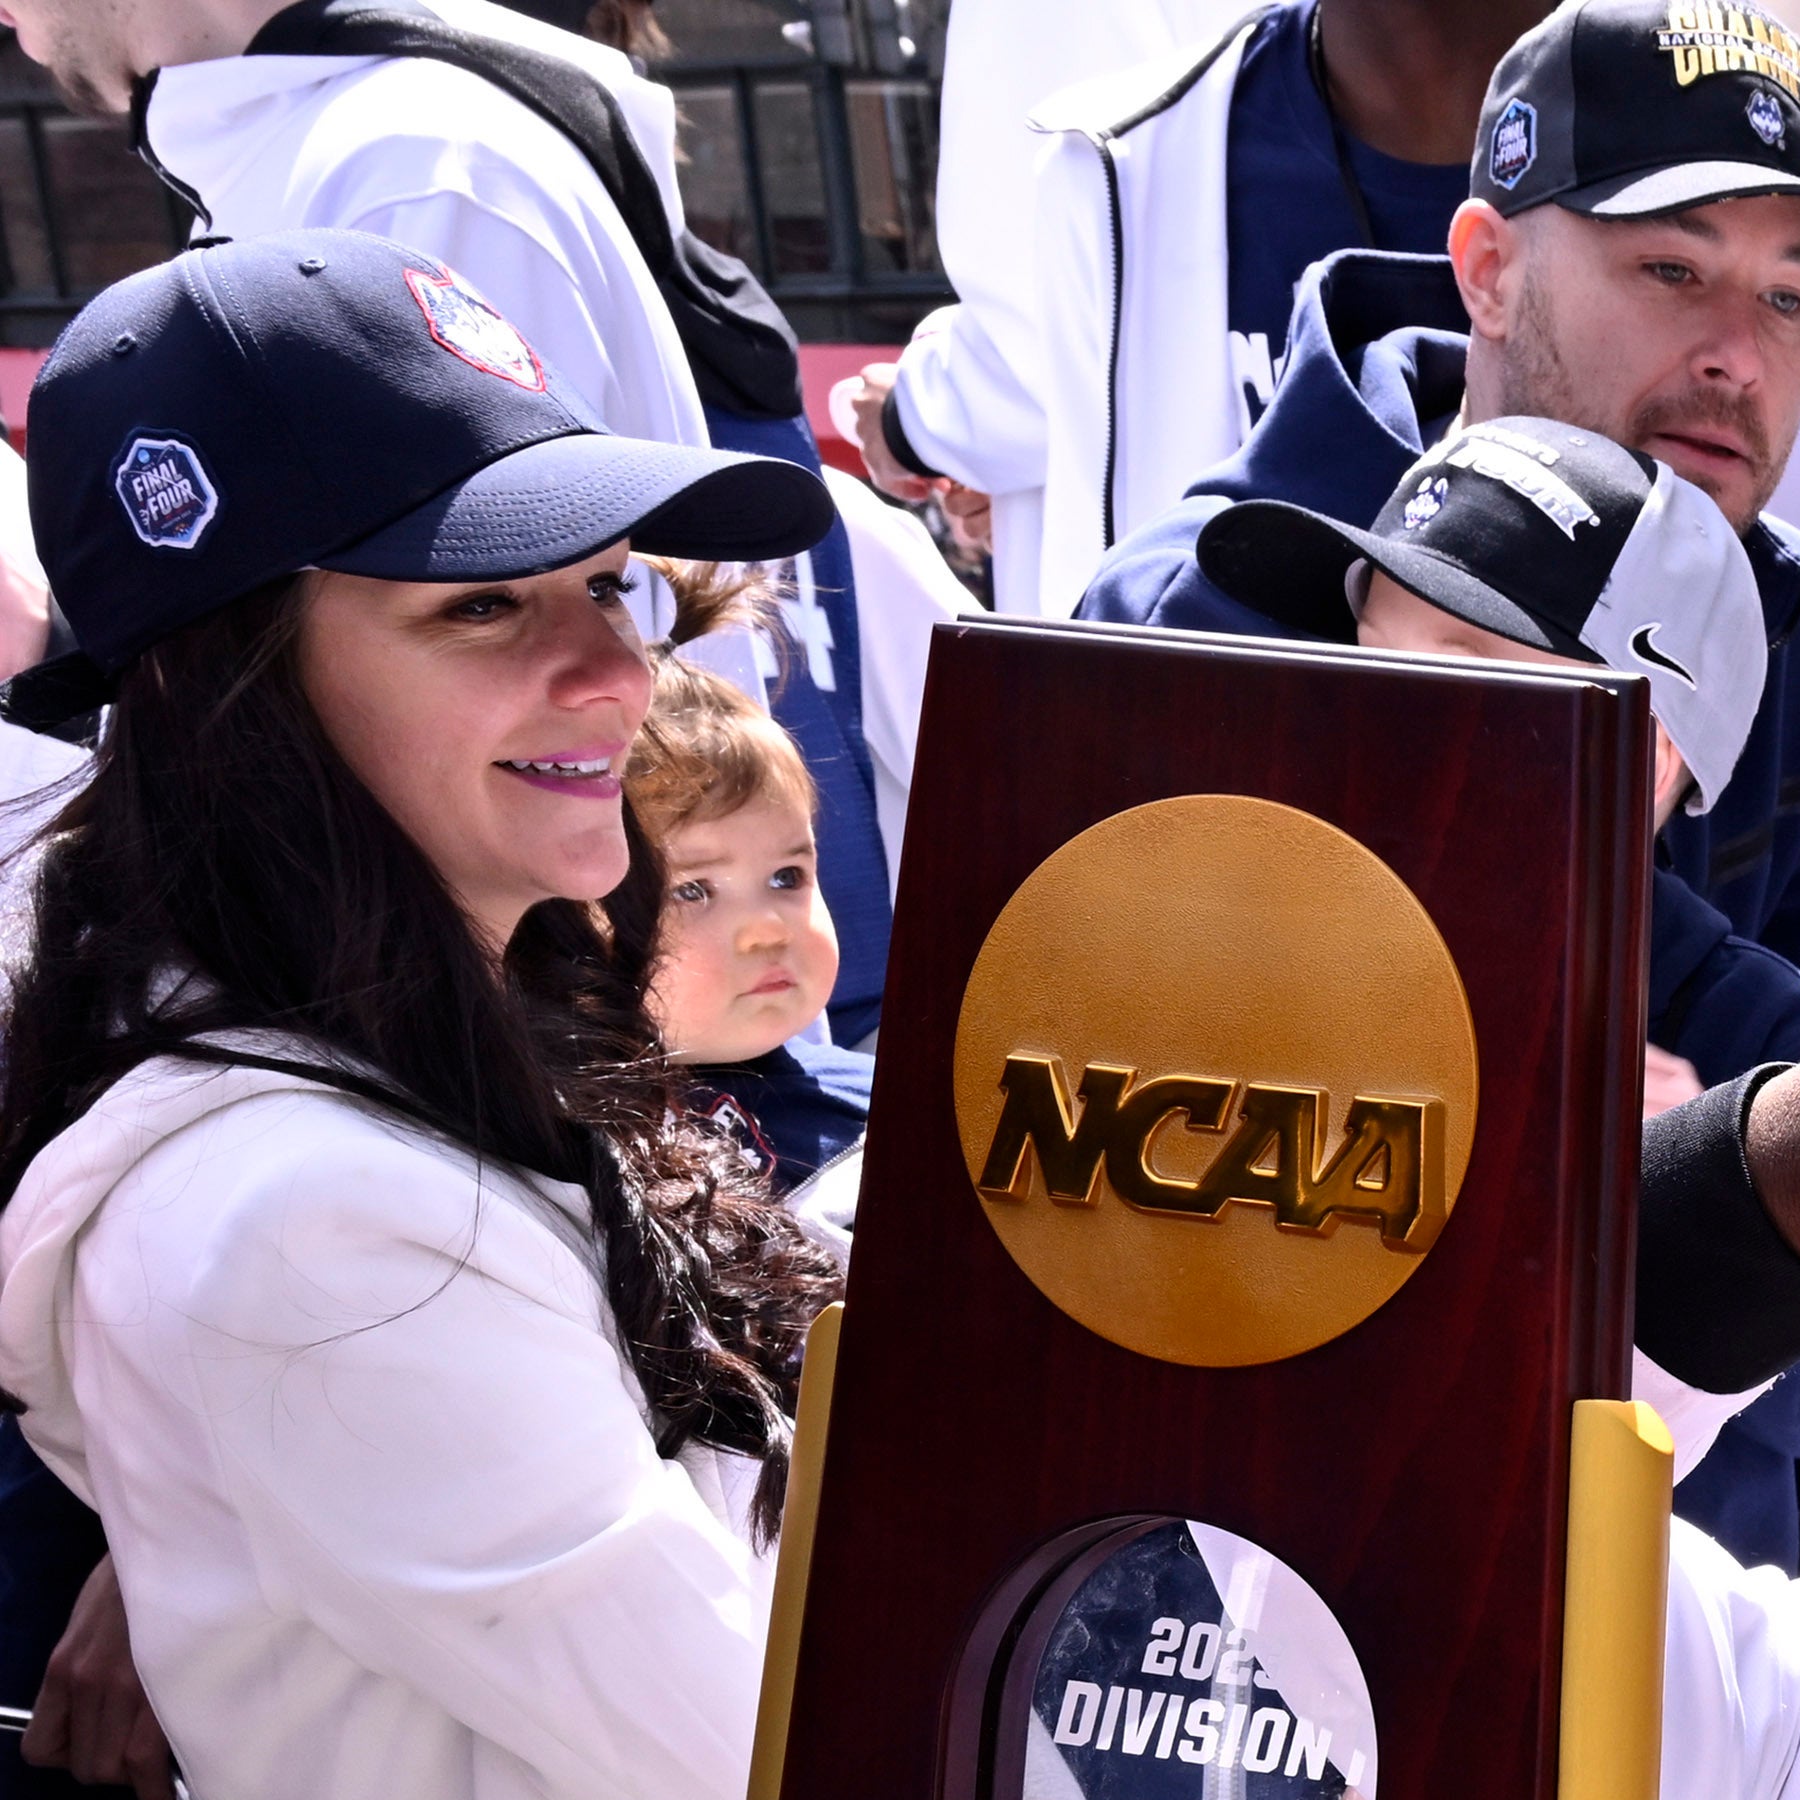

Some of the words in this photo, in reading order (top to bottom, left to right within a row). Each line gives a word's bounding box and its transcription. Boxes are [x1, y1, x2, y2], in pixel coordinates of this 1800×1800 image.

[132, 458, 182, 502] FINAL
[147, 478, 196, 521] FOUR
[978, 1049, 1448, 1253] NCAA
[1052, 1679, 1334, 1782] DIVISION
